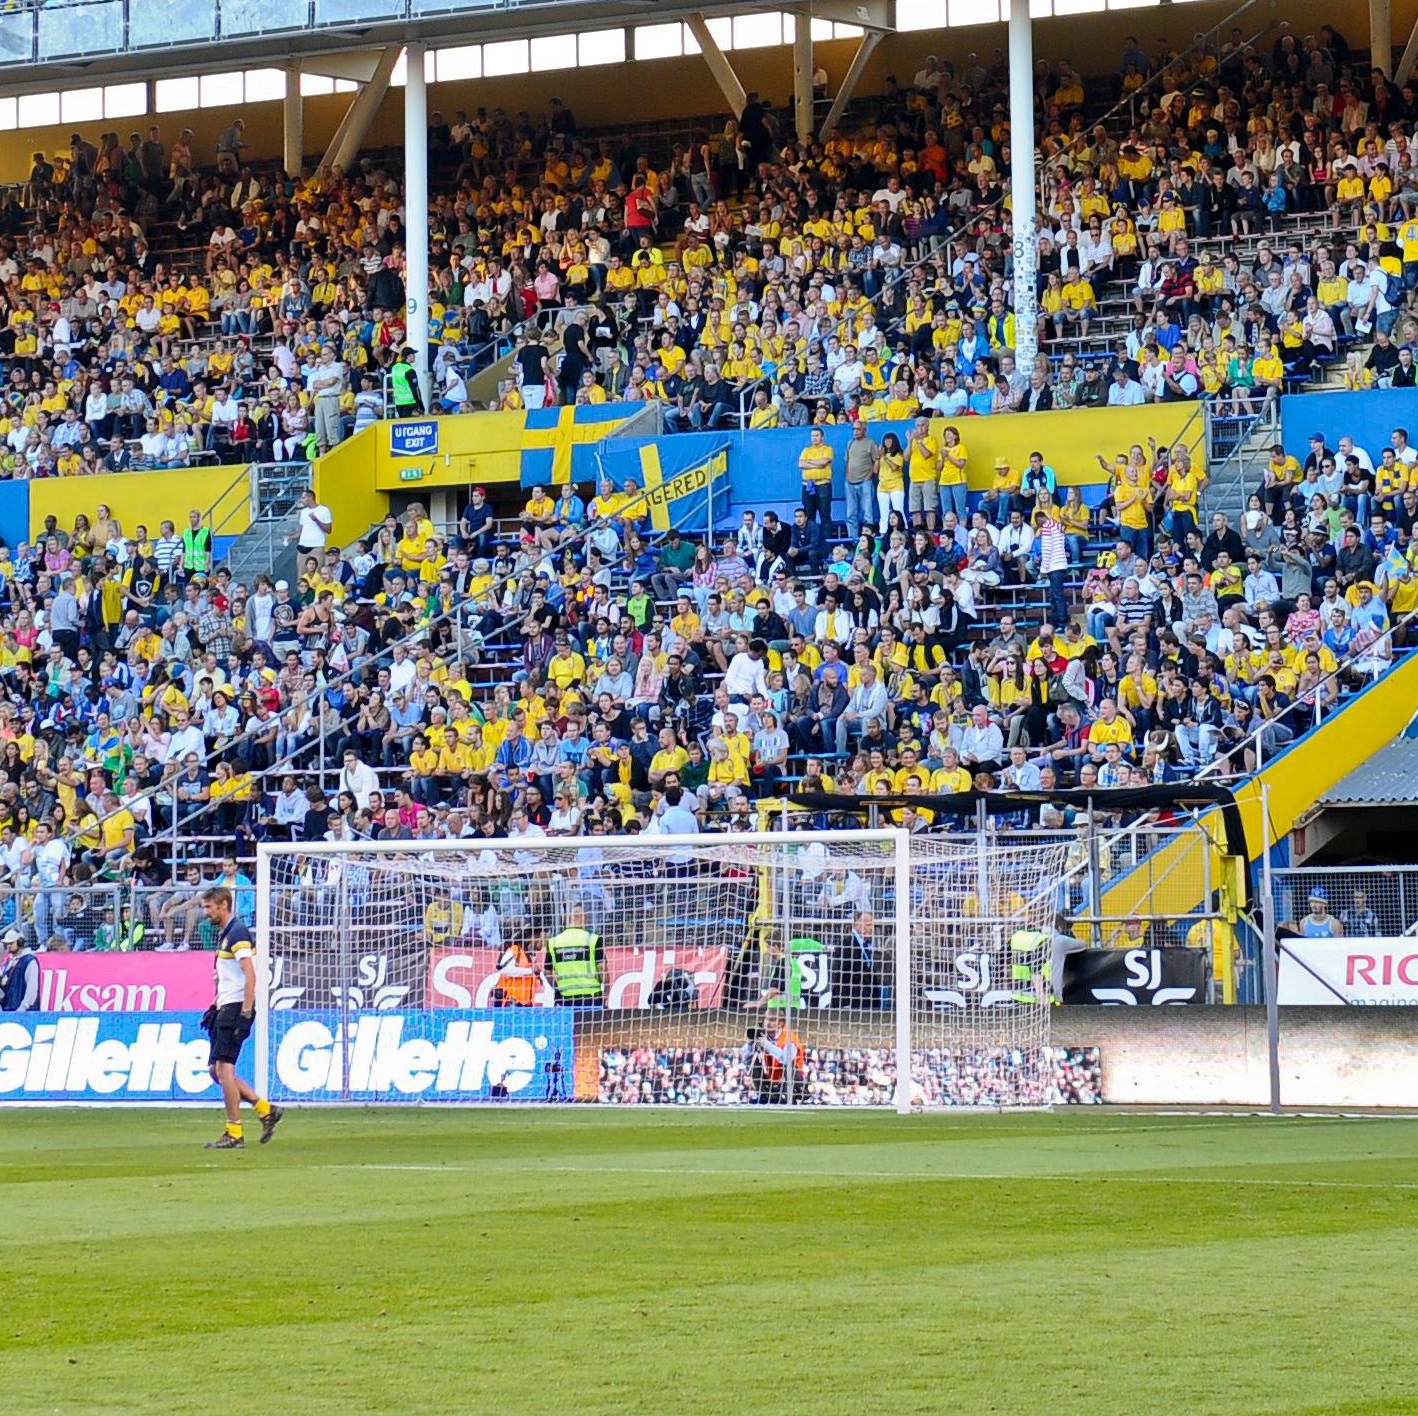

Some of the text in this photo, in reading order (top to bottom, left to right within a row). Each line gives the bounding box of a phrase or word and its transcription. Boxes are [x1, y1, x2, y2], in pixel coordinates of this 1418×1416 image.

[1014, 240, 1024, 259] 8
[407, 297, 418, 315] 9
[404, 437, 426, 449] EXIT
[359, 954, 388, 986] SJ
[797, 953, 829, 993] SJ
[955, 953, 991, 991] SJ
[1124, 949, 1161, 990] SJ
[277, 1016, 535, 1093] Gillette
